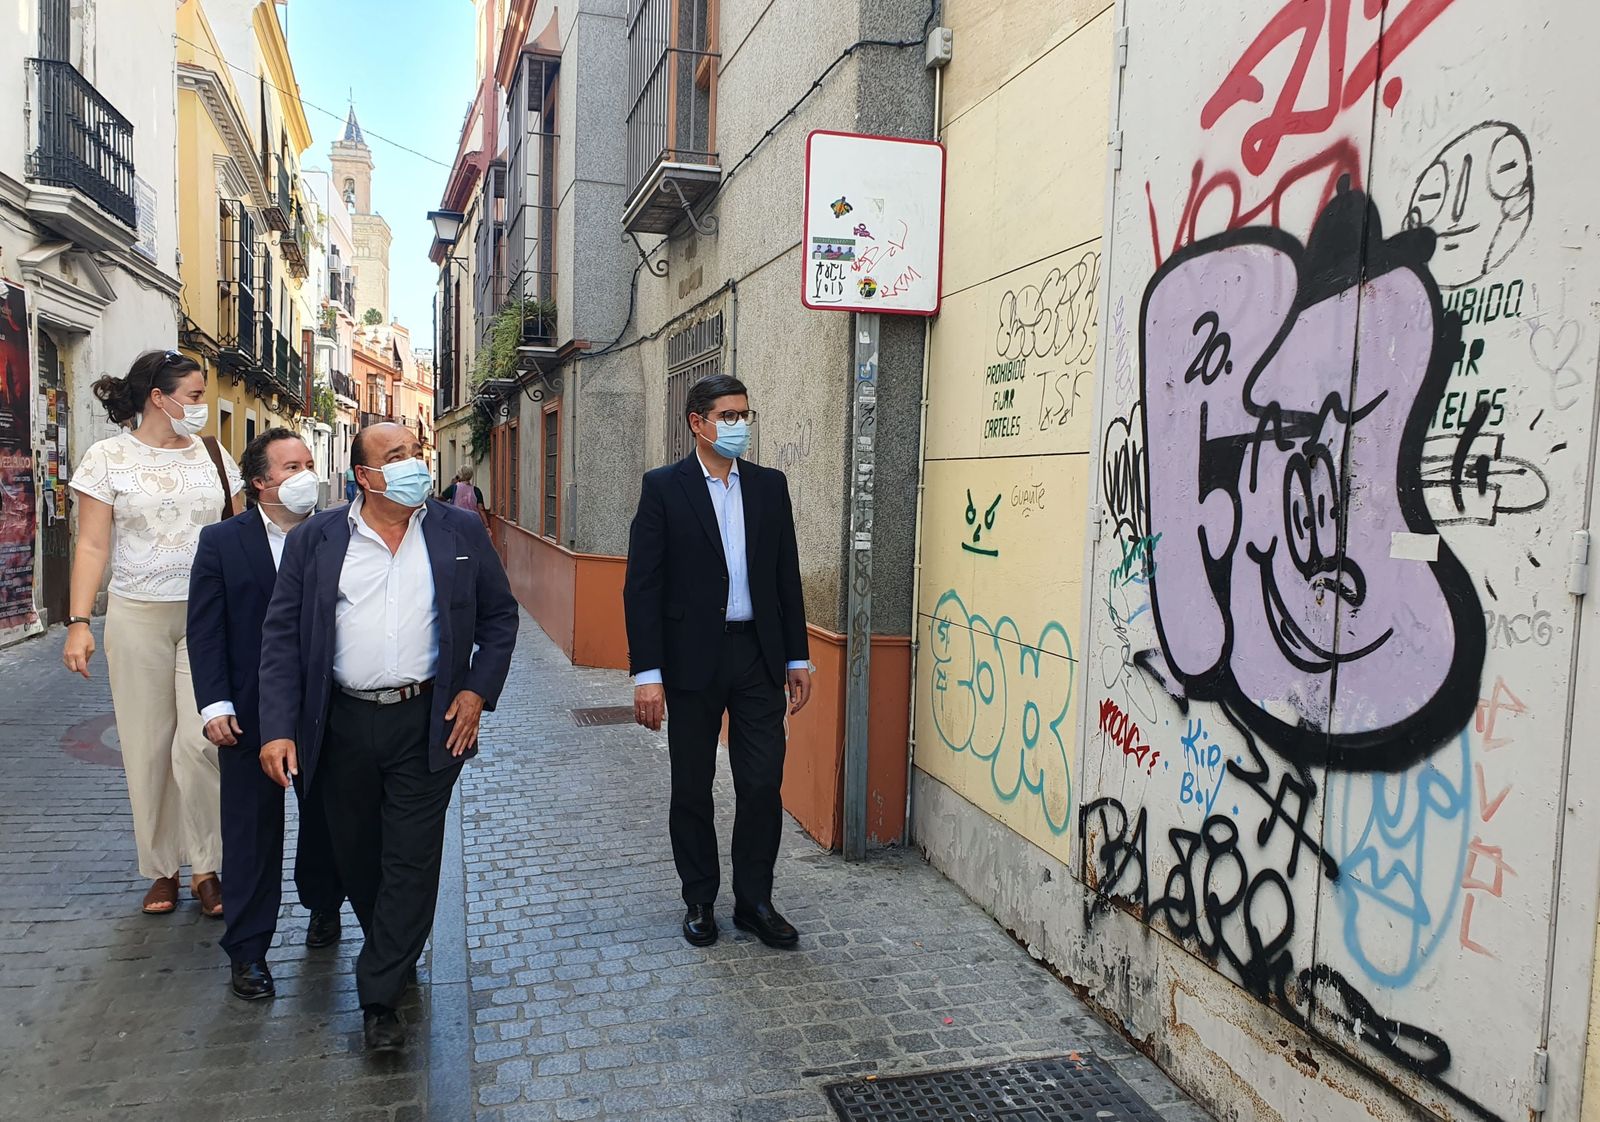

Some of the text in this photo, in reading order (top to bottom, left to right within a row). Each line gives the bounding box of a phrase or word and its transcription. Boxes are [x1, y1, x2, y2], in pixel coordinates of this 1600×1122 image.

[985, 358, 1027, 386] PROHIBIDO
[992, 388, 1016, 412] FIJAR
[984, 415, 1022, 440] CARTELES
